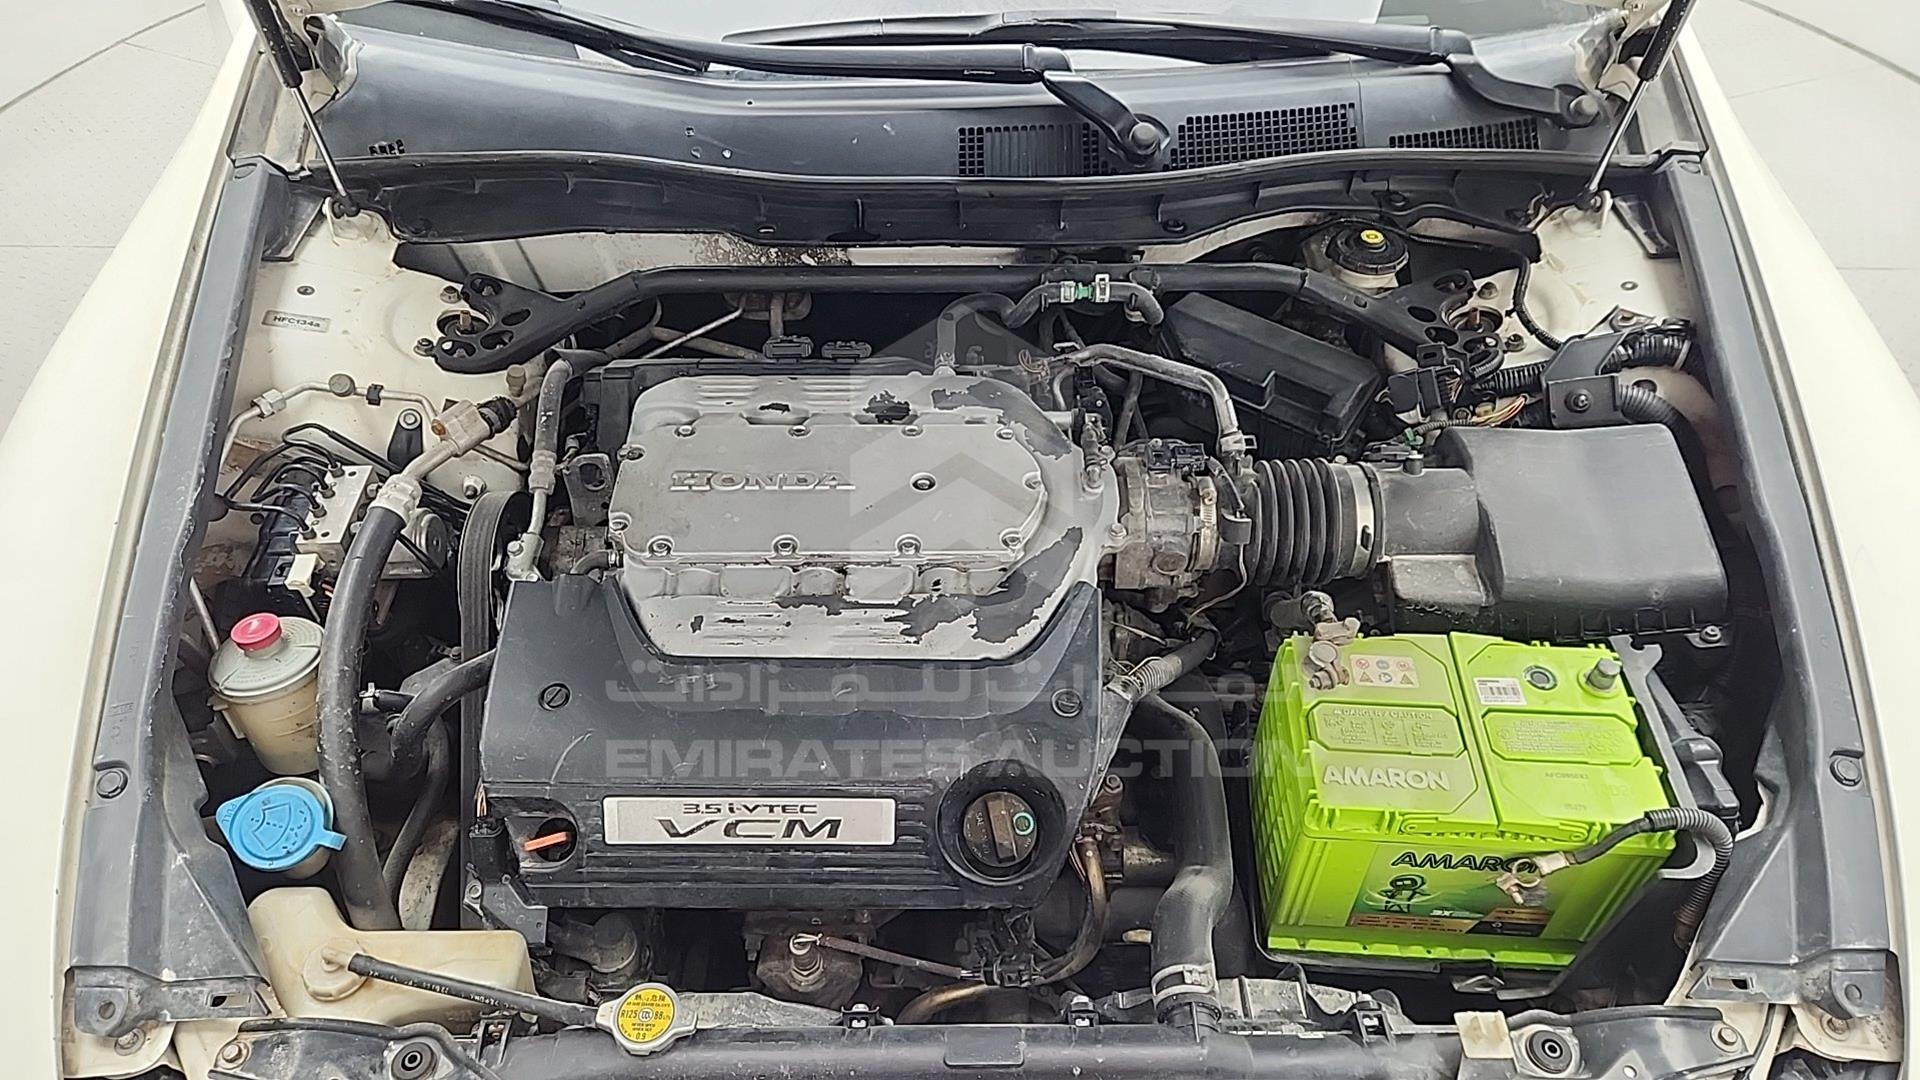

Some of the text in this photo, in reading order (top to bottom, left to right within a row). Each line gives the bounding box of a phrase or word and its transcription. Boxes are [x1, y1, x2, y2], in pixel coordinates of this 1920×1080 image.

[273, 315, 321, 328] HFC134a
[669, 470, 857, 491] HONDA
[1323, 765, 1449, 791] AMARON
[682, 803, 818, 815] 3.5 i-VTEC
[657, 818, 844, 839] VCM
